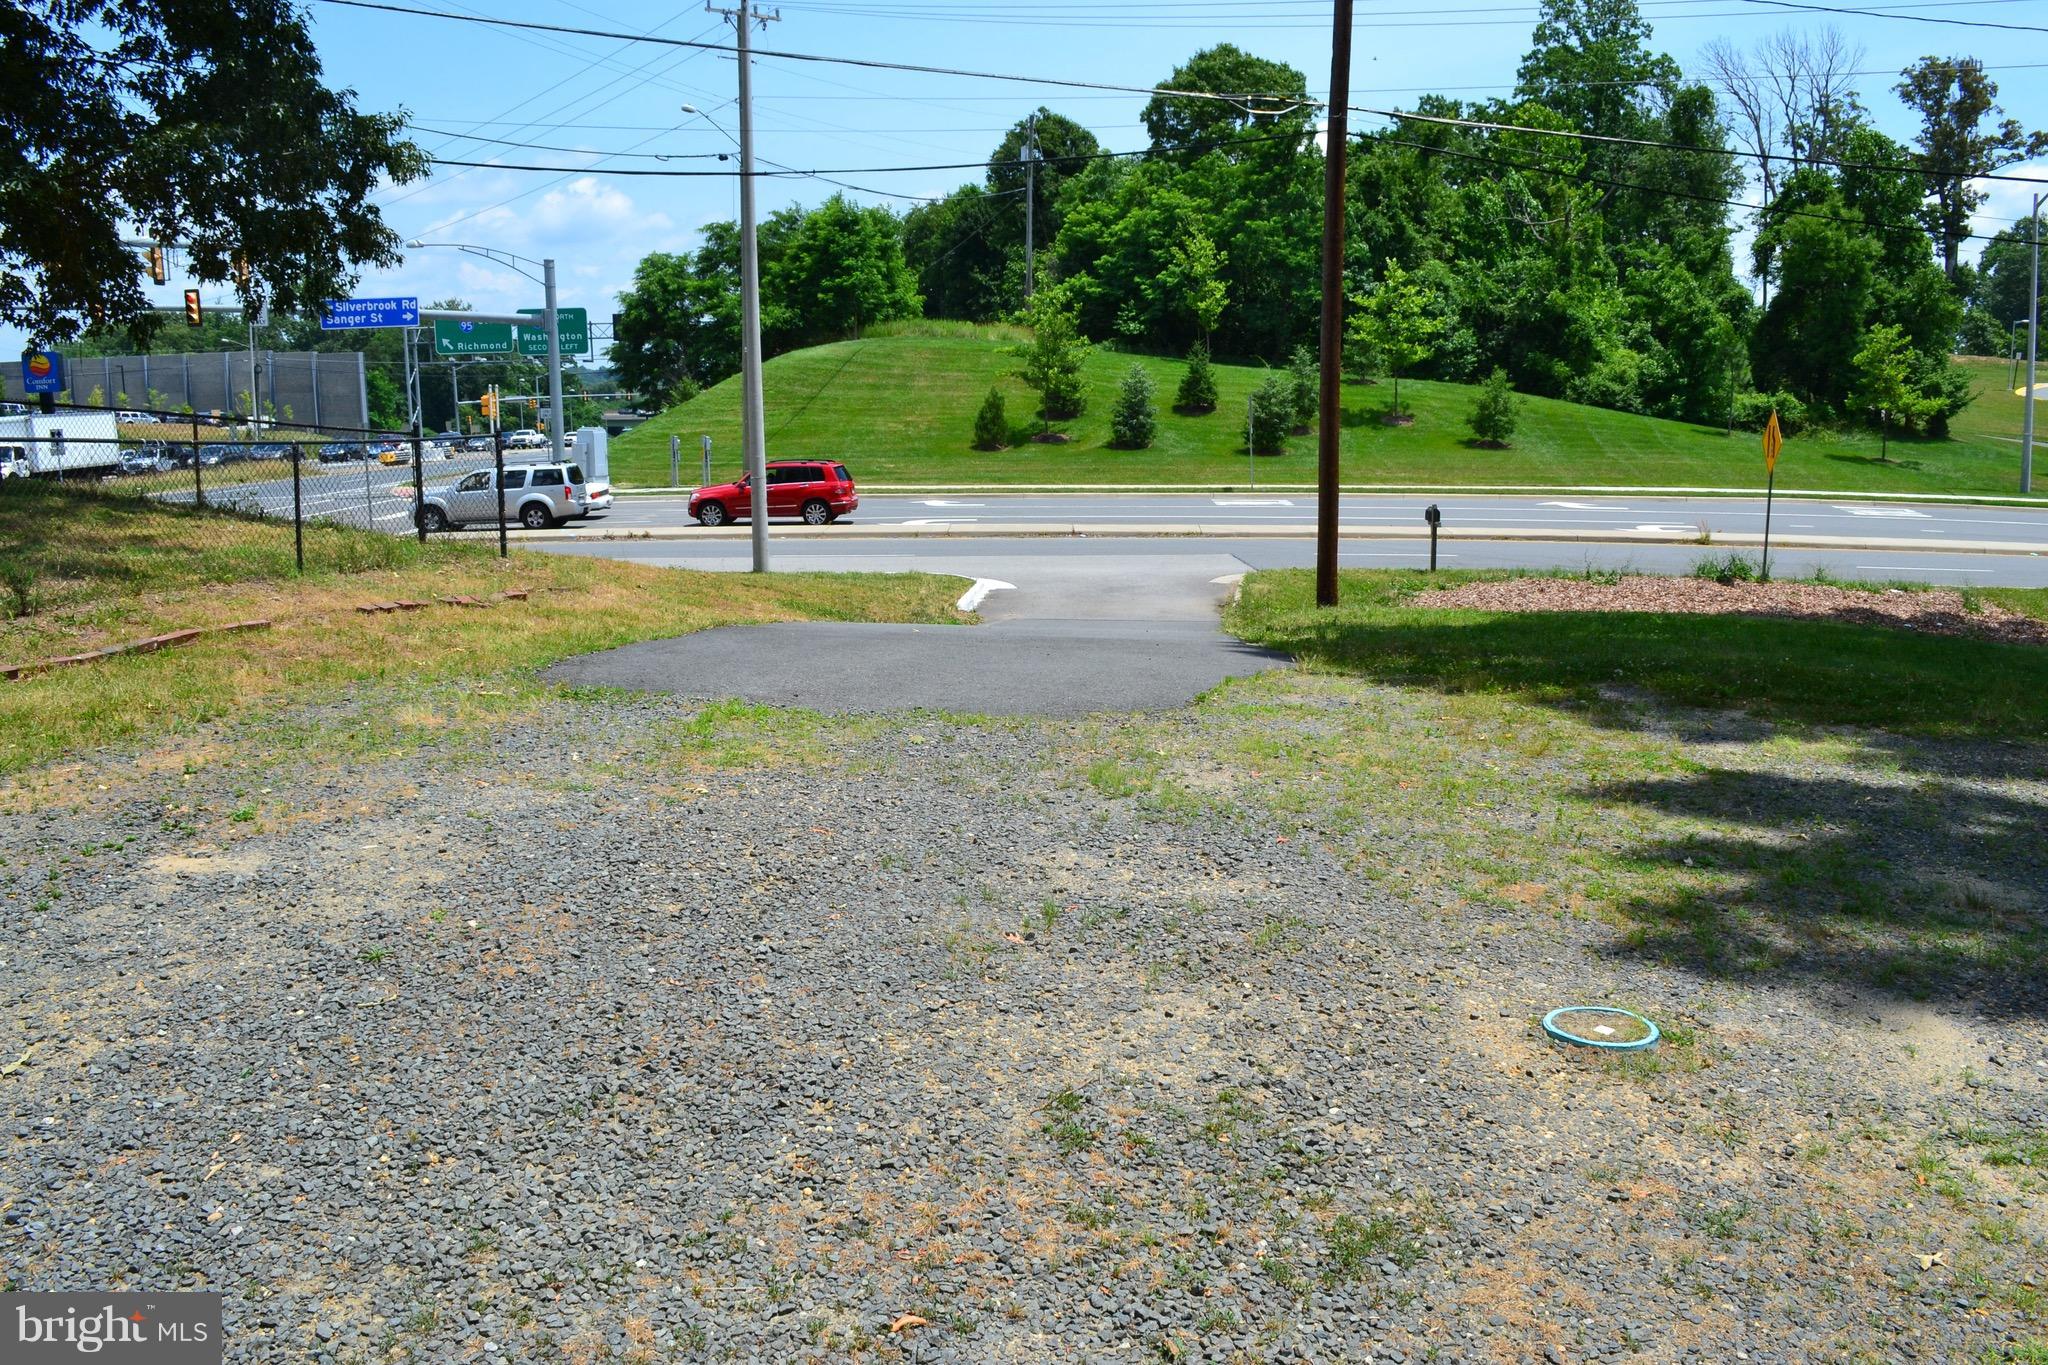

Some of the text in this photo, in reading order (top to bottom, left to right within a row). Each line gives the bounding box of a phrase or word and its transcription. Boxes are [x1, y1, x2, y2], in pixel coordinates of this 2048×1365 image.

[335, 299, 417, 312] Silverbrook Rd
[326, 312, 383, 326] Sanger St
[461, 321, 473, 331] 95
[523, 332, 583, 342] Washgton
[457, 341, 507, 351] Richmond
[26, 377, 56, 385] Comfort
